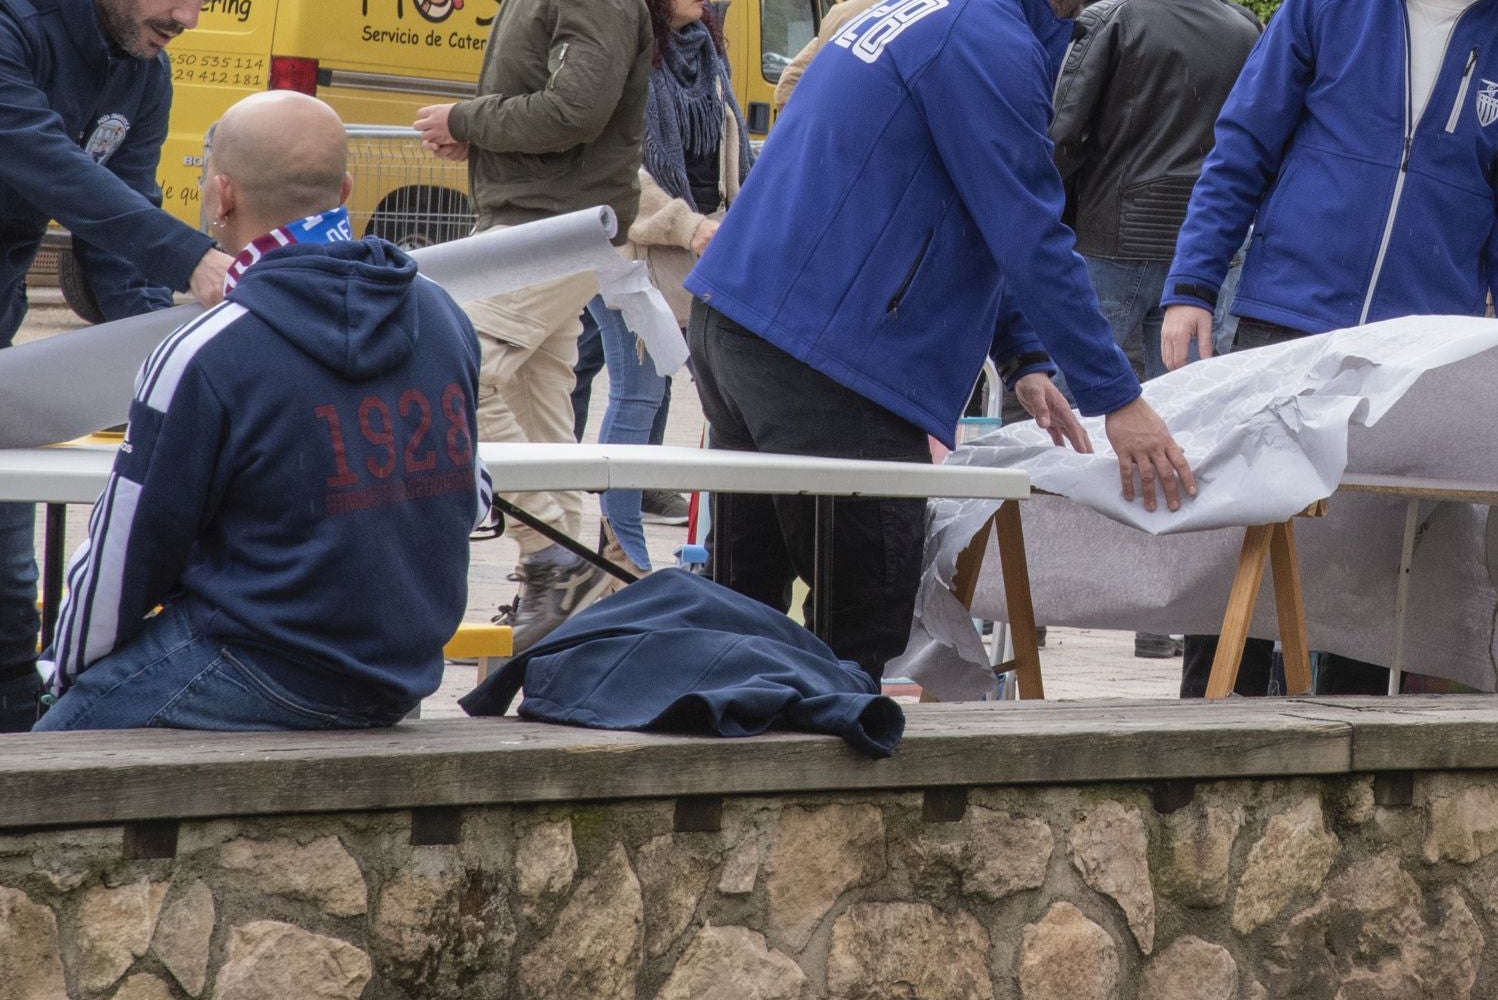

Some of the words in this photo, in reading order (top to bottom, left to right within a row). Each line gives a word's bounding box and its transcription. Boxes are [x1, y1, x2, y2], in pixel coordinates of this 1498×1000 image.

[361, 25, 420, 46] Servicio
[425, 29, 442, 47] de
[448, 31, 487, 51] Cater
[200, 55, 232, 68] 535
[234, 57, 264, 70] 114
[172, 69, 194, 81] 29
[198, 70, 228, 84] 412
[232, 73, 262, 86] 181
[183, 156, 204, 167] BO
[315, 382, 473, 488] 1928
